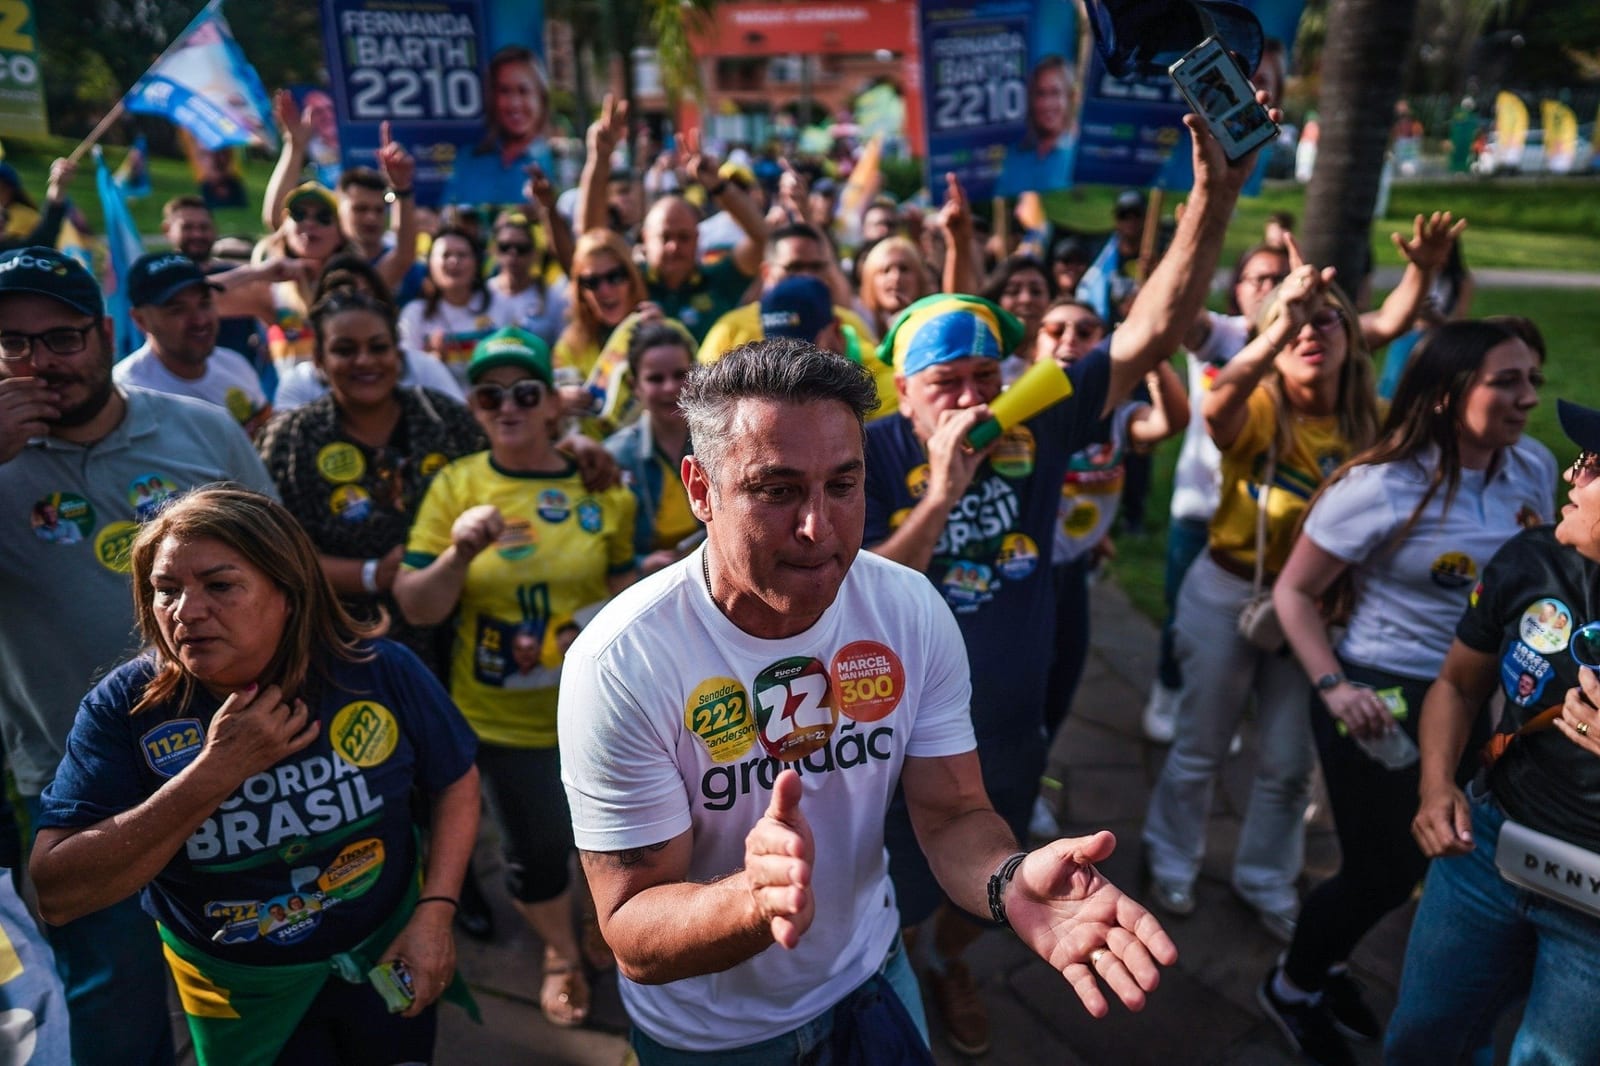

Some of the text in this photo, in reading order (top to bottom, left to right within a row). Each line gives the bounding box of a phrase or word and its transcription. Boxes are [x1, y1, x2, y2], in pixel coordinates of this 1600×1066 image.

[341, 11, 474, 35] FERNANDA
[357, 36, 469, 66] BARTH
[352, 69, 482, 117] 2210
[937, 81, 1026, 127] 2210
[837, 656, 890, 673] MARCEL
[840, 666, 891, 680] VAN HATTEM
[698, 684, 736, 705] Senador
[840, 675, 893, 703] 300
[696, 696, 743, 734] 222
[757, 673, 833, 743] 22
[148, 728, 201, 758] 1122
[345, 710, 378, 758] 222
[815, 731, 825, 740] 22
[219, 751, 361, 811] ORDA
[701, 721, 894, 811] gradão
[186, 774, 385, 861] BRASIL
[1524, 853, 1600, 894] DKNY
[277, 917, 314, 939] ZUCCO
